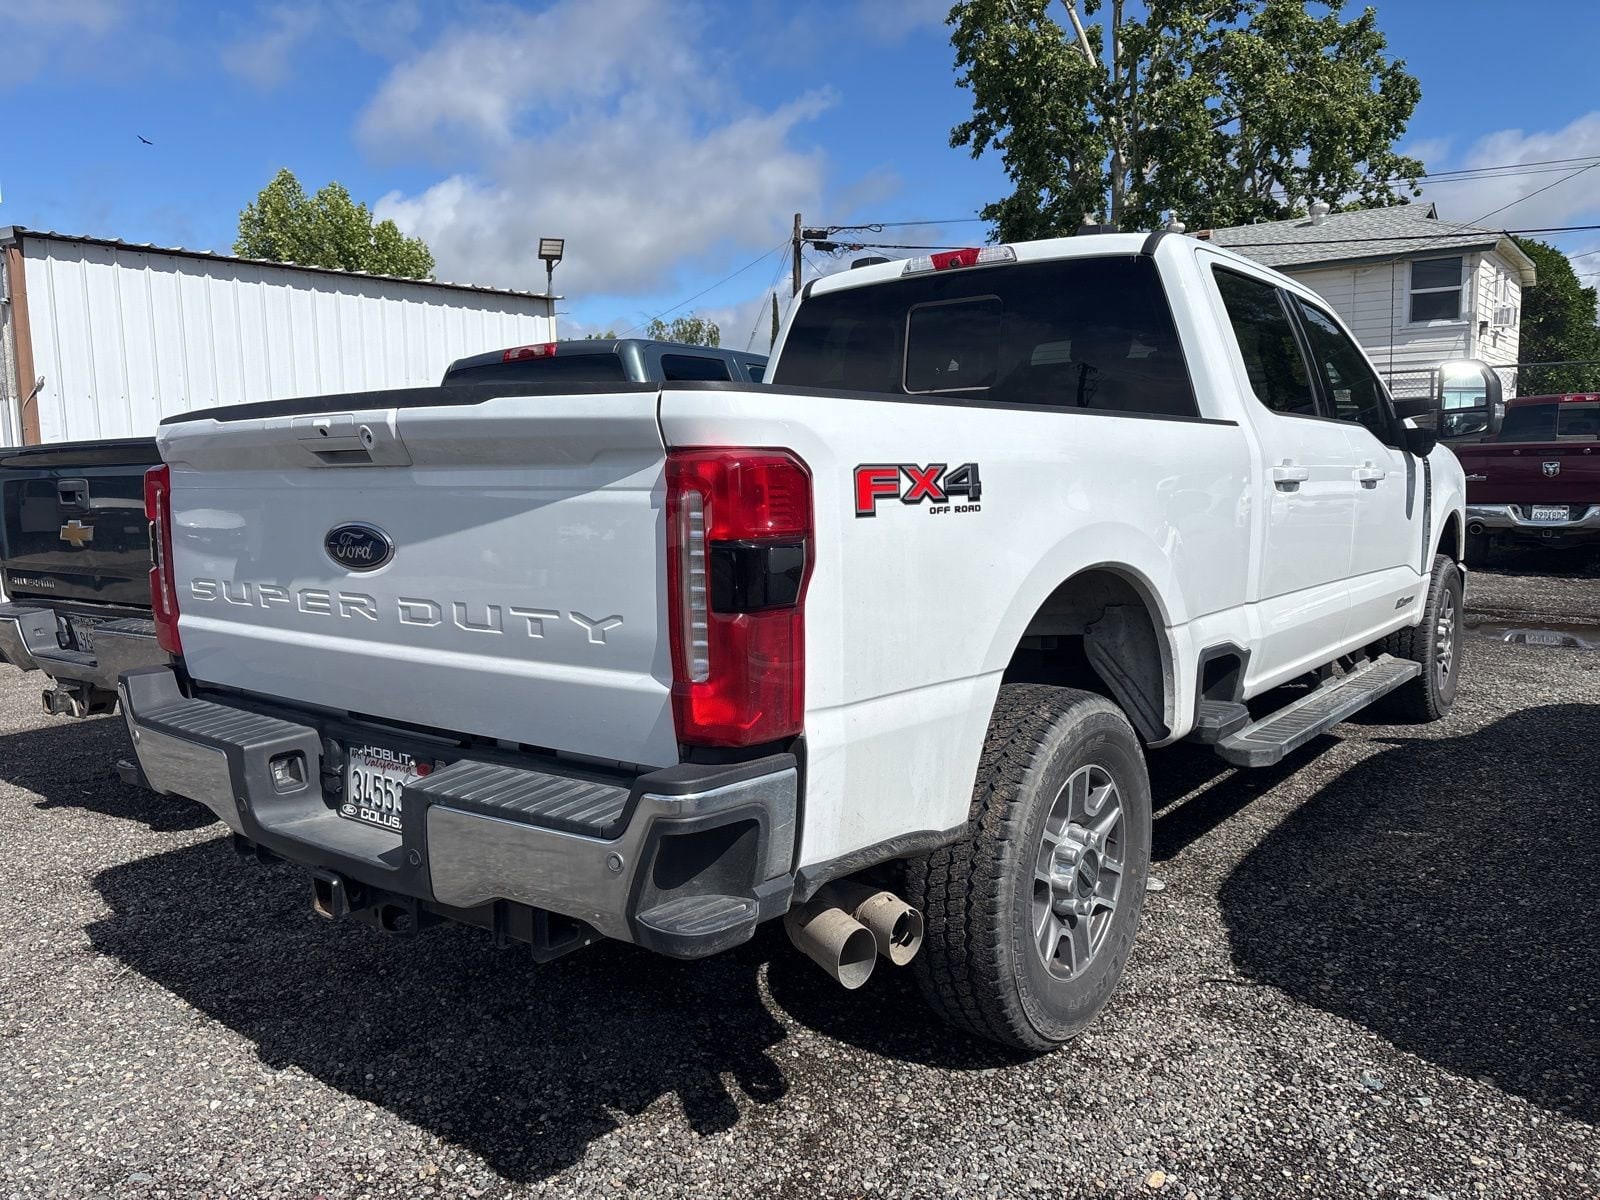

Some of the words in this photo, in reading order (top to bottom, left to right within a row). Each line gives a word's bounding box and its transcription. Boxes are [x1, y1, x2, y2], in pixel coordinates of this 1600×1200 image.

[853, 463, 982, 518] FX4
[930, 506, 950, 515] OFF
[954, 504, 982, 514] ROAD
[336, 532, 373, 559] Ford
[191, 576, 378, 621] SUPER
[398, 596, 624, 645] DUTY
[364, 745, 411, 765] HOBLIT
[360, 808, 402, 829] COLUS
